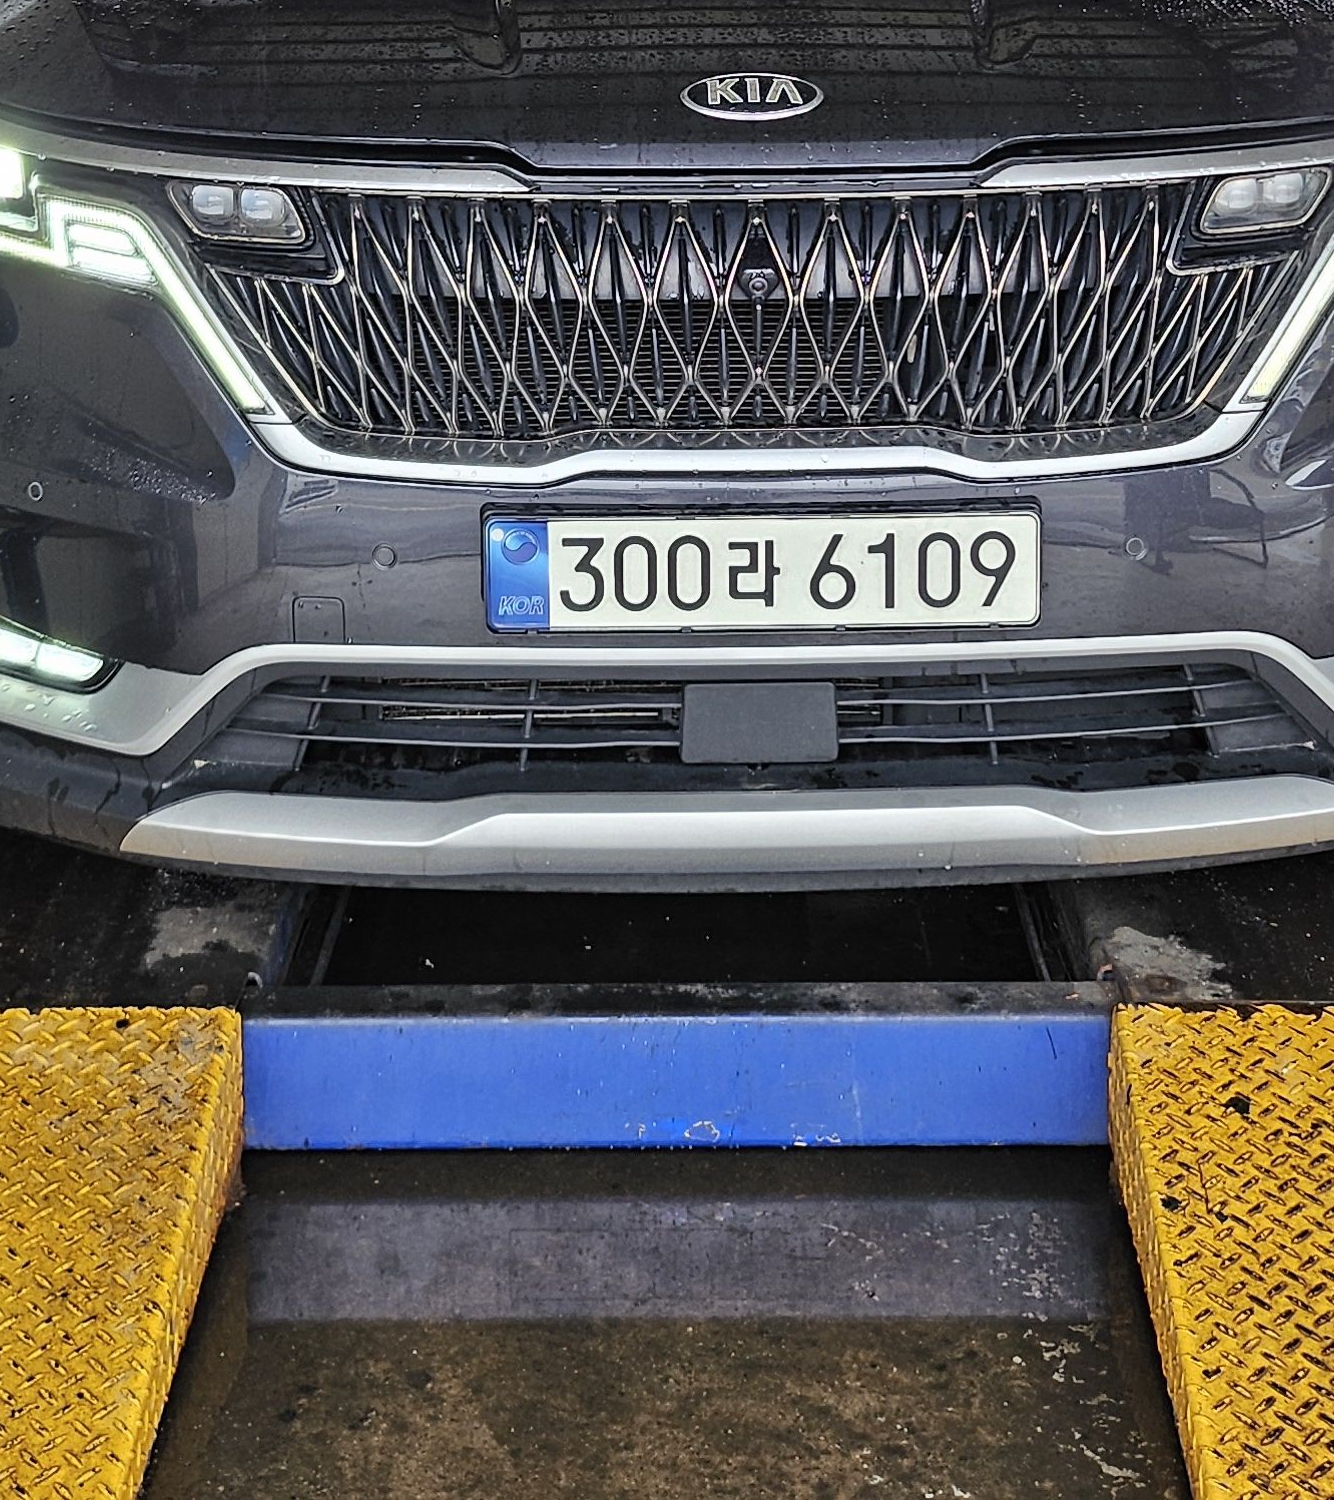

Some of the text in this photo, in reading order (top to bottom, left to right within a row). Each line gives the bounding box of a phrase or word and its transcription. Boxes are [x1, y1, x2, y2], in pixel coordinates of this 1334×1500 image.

[705, 77, 804, 105] KIA
[559, 530, 1017, 612] 300라 6109
[498, 596, 545, 616] KOR
